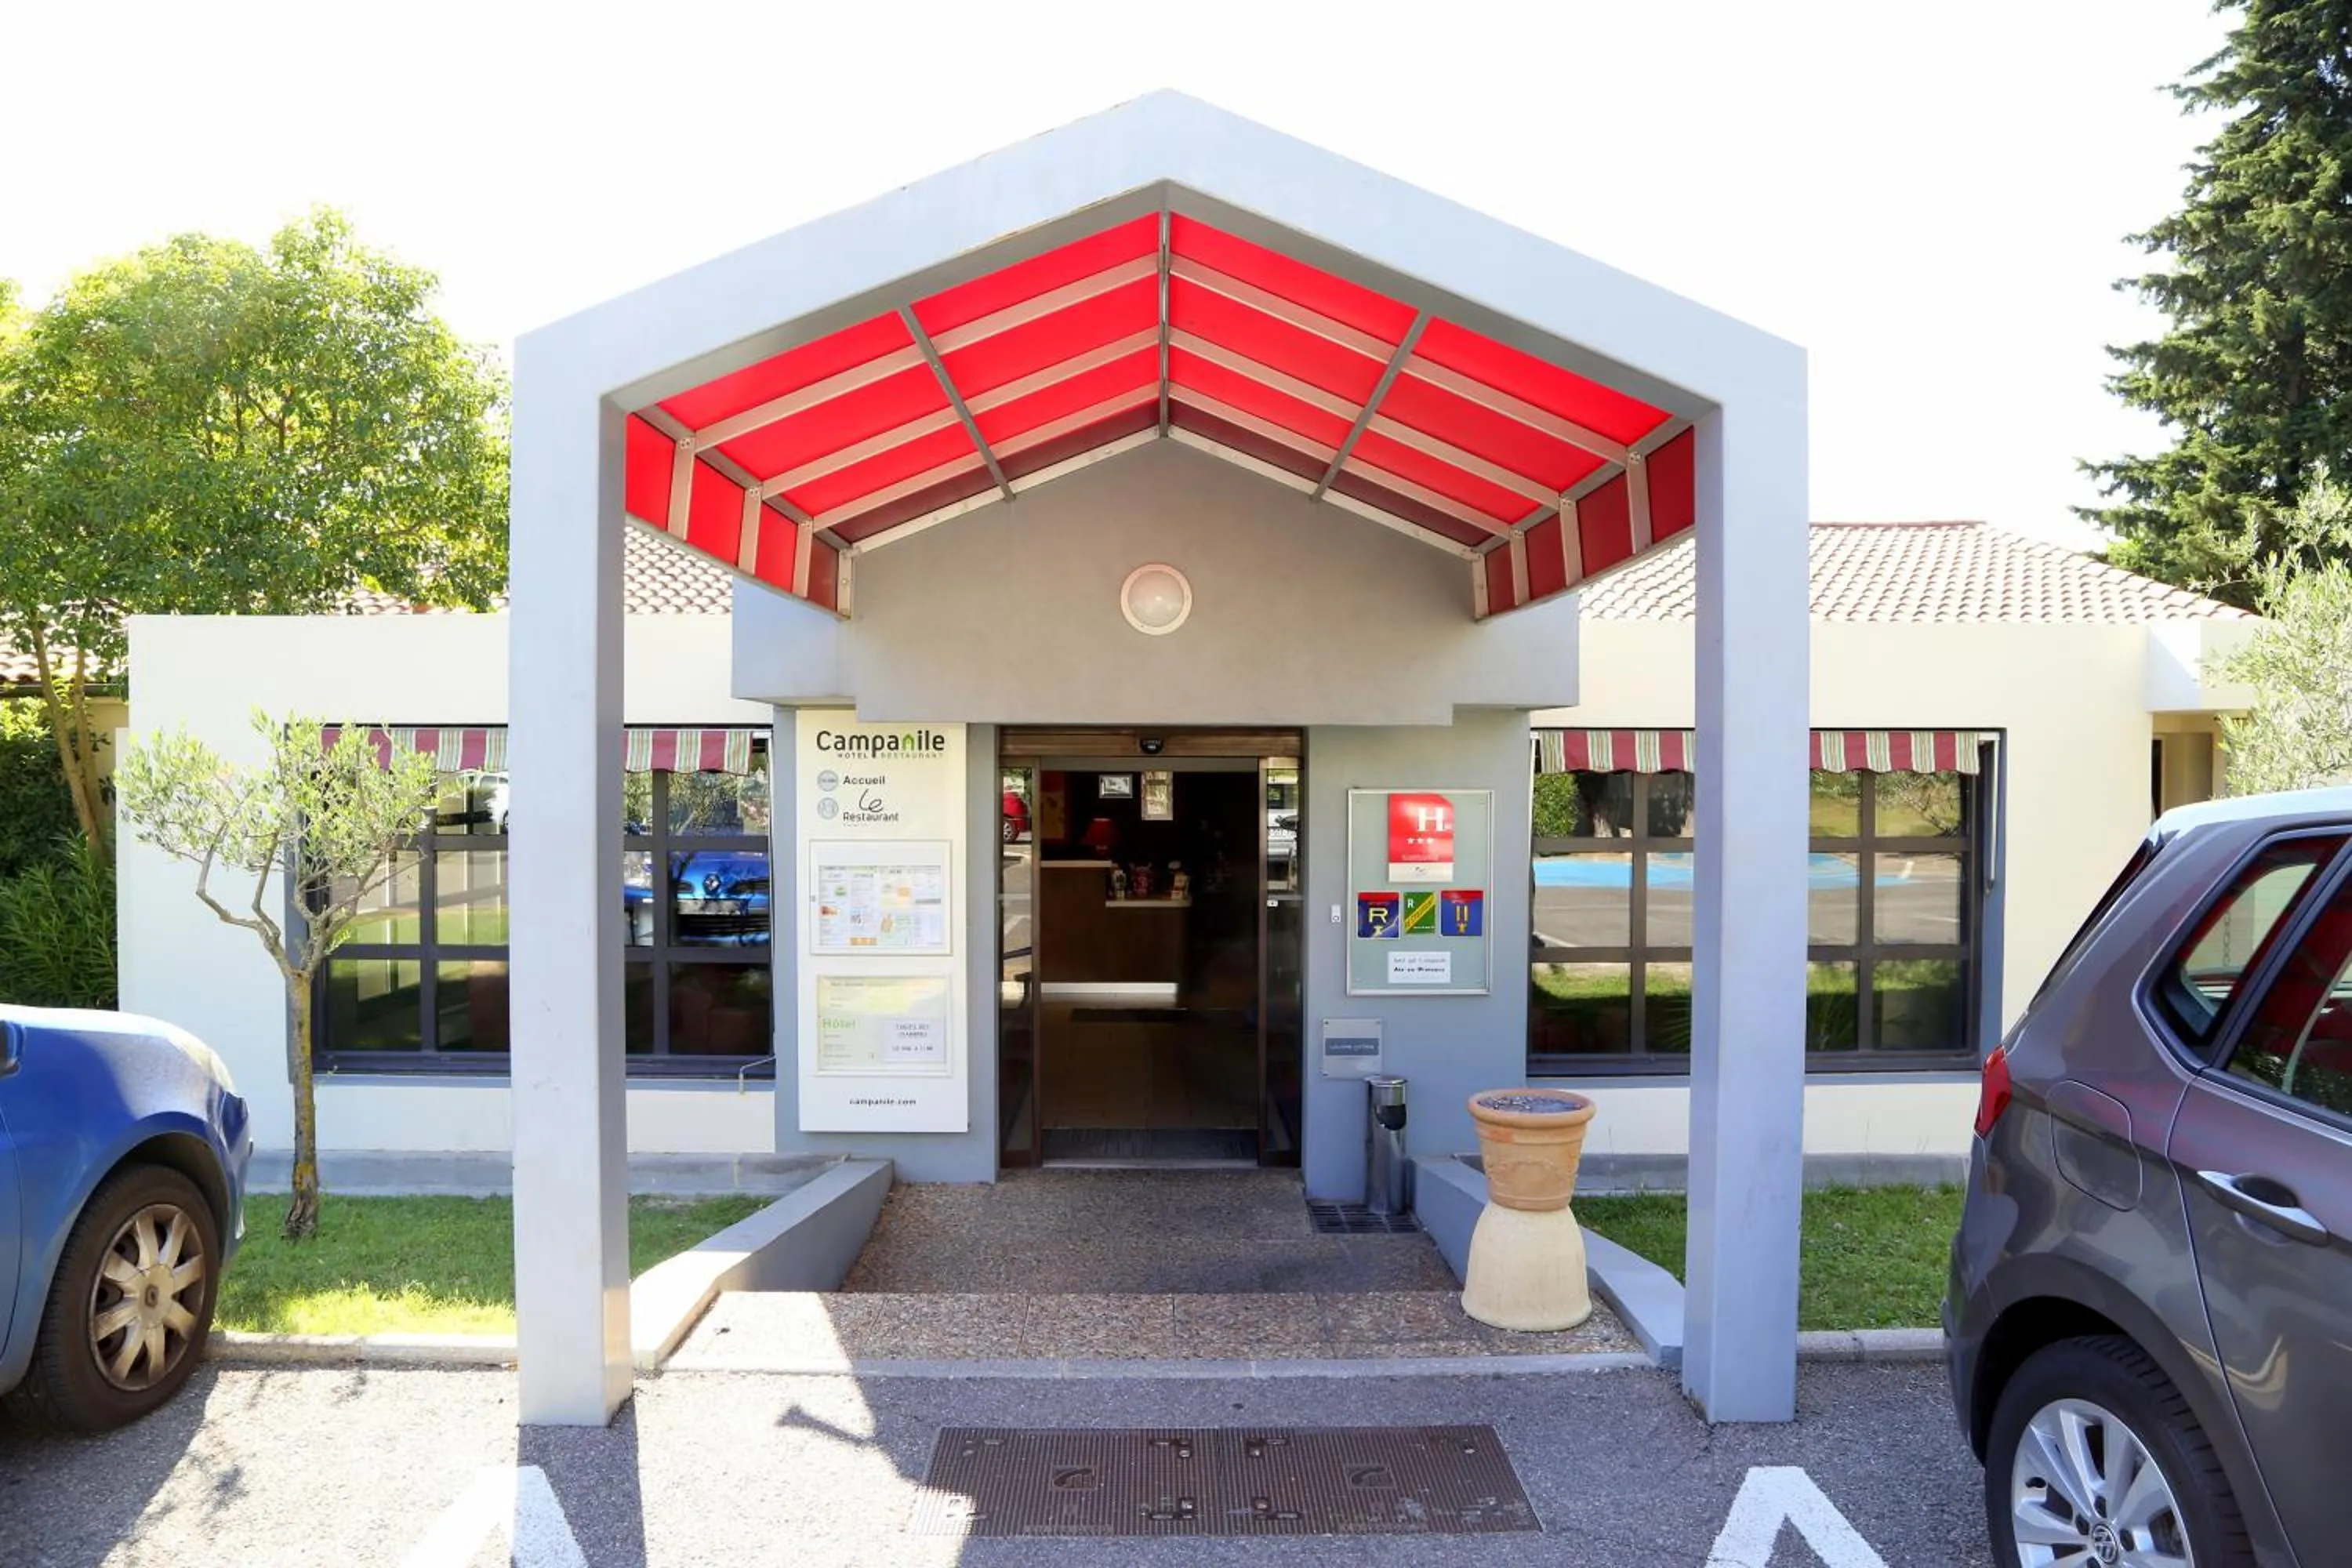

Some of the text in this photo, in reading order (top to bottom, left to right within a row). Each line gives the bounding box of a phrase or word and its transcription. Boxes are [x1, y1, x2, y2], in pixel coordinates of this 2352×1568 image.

[816, 730, 945, 758] Campanile
[843, 775, 885, 785] Accueil
[858, 789, 884, 812] Le
[843, 812, 899, 822] Restaurant
[1417, 807, 1444, 832] H
[1368, 907, 1388, 923] R
[849, 1098, 916, 1108] campanile.com
